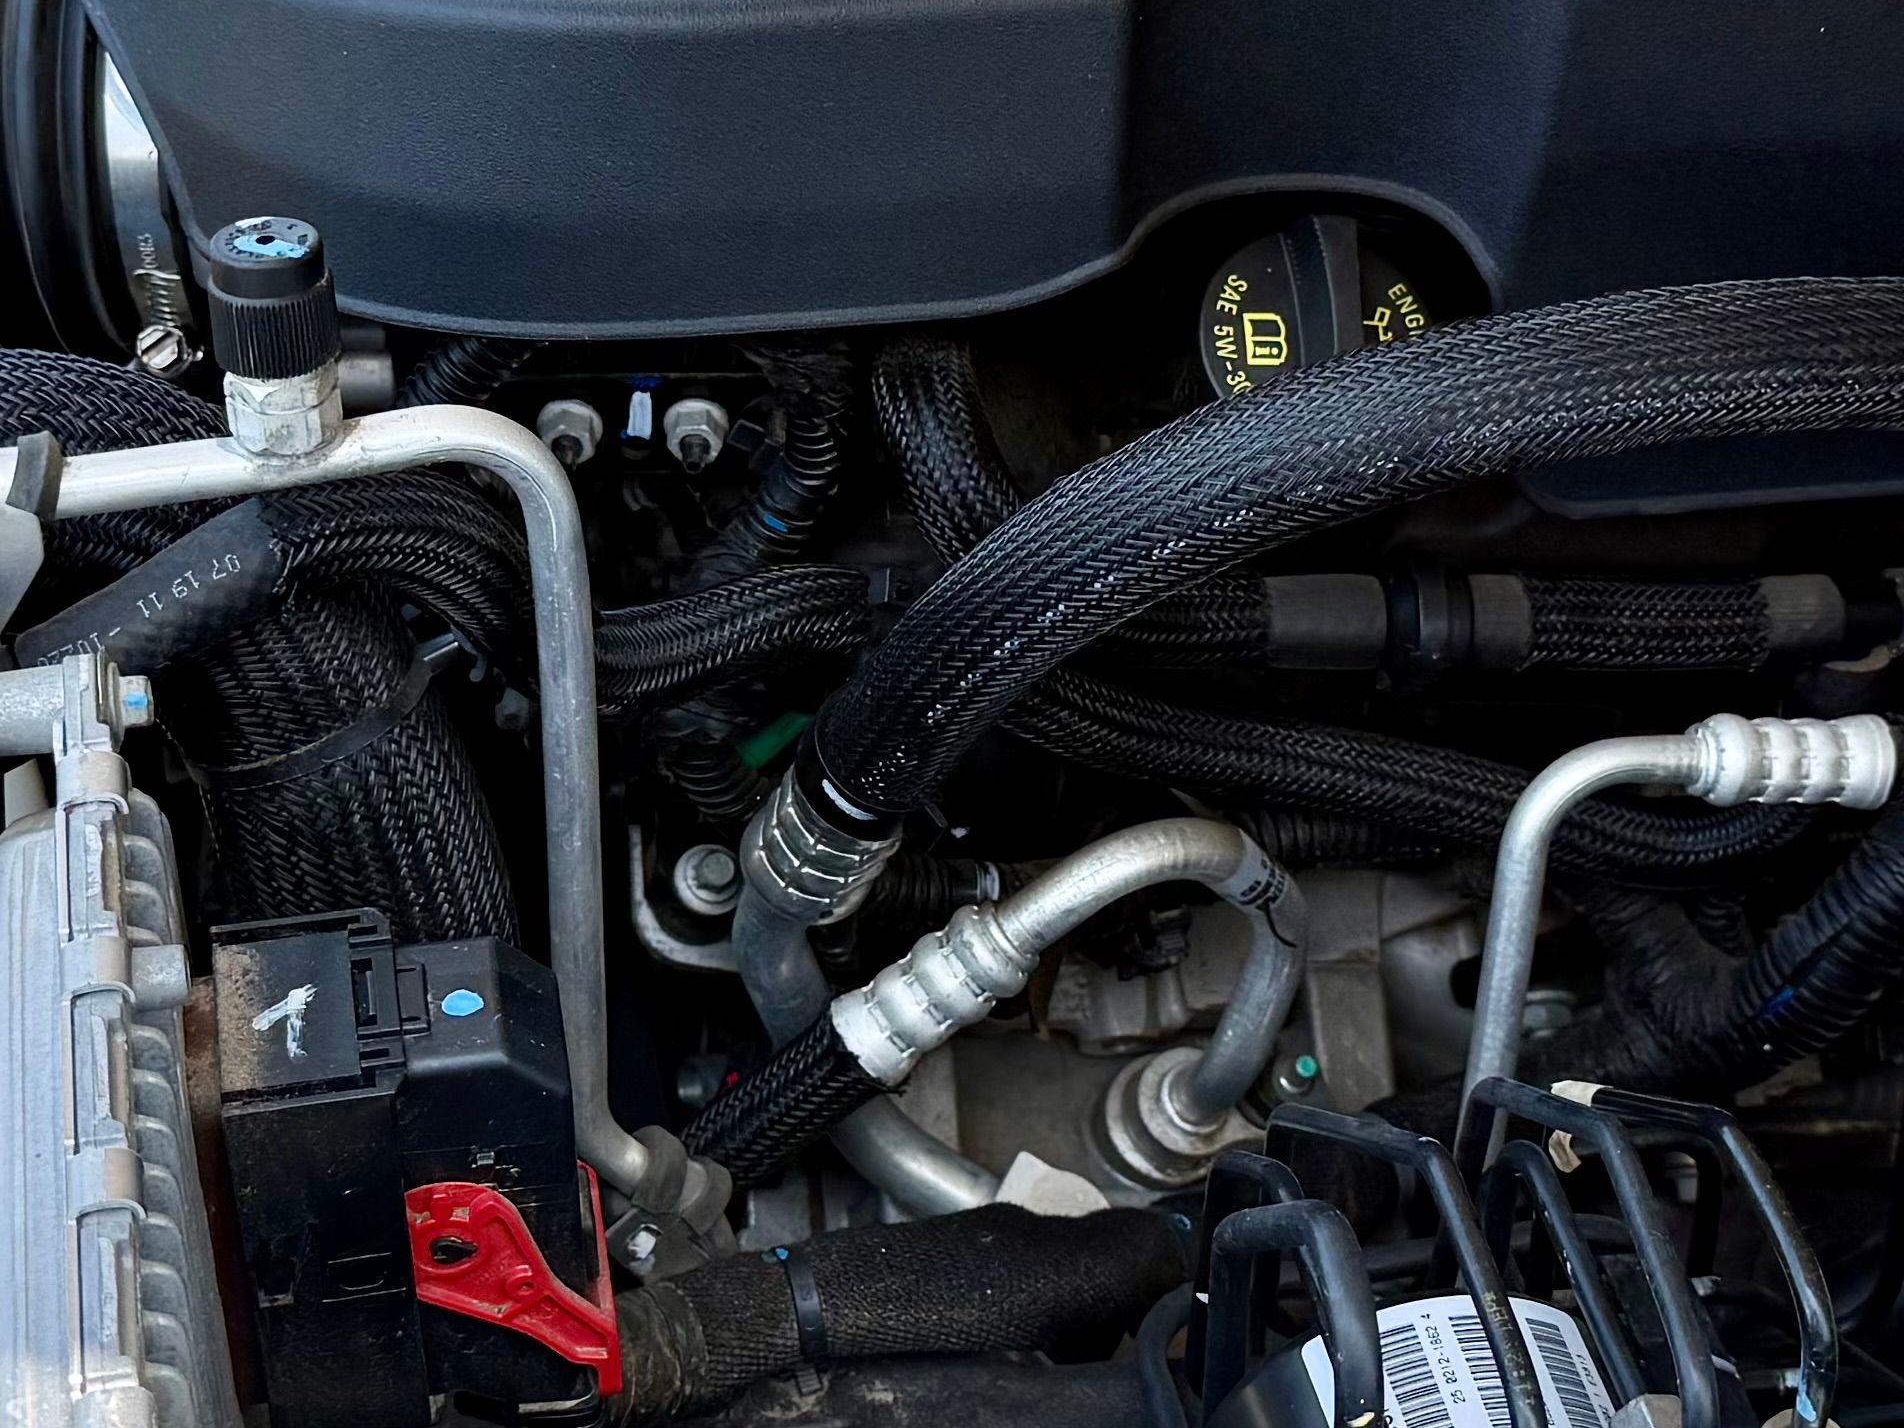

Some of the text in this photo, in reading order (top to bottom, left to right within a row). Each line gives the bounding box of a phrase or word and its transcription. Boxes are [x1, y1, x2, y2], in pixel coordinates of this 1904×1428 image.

[1215, 273, 1248, 317] SAE
[211, 552, 242, 582] 07
[171, 569, 201, 600] 19
[136, 591, 165, 619] 11
